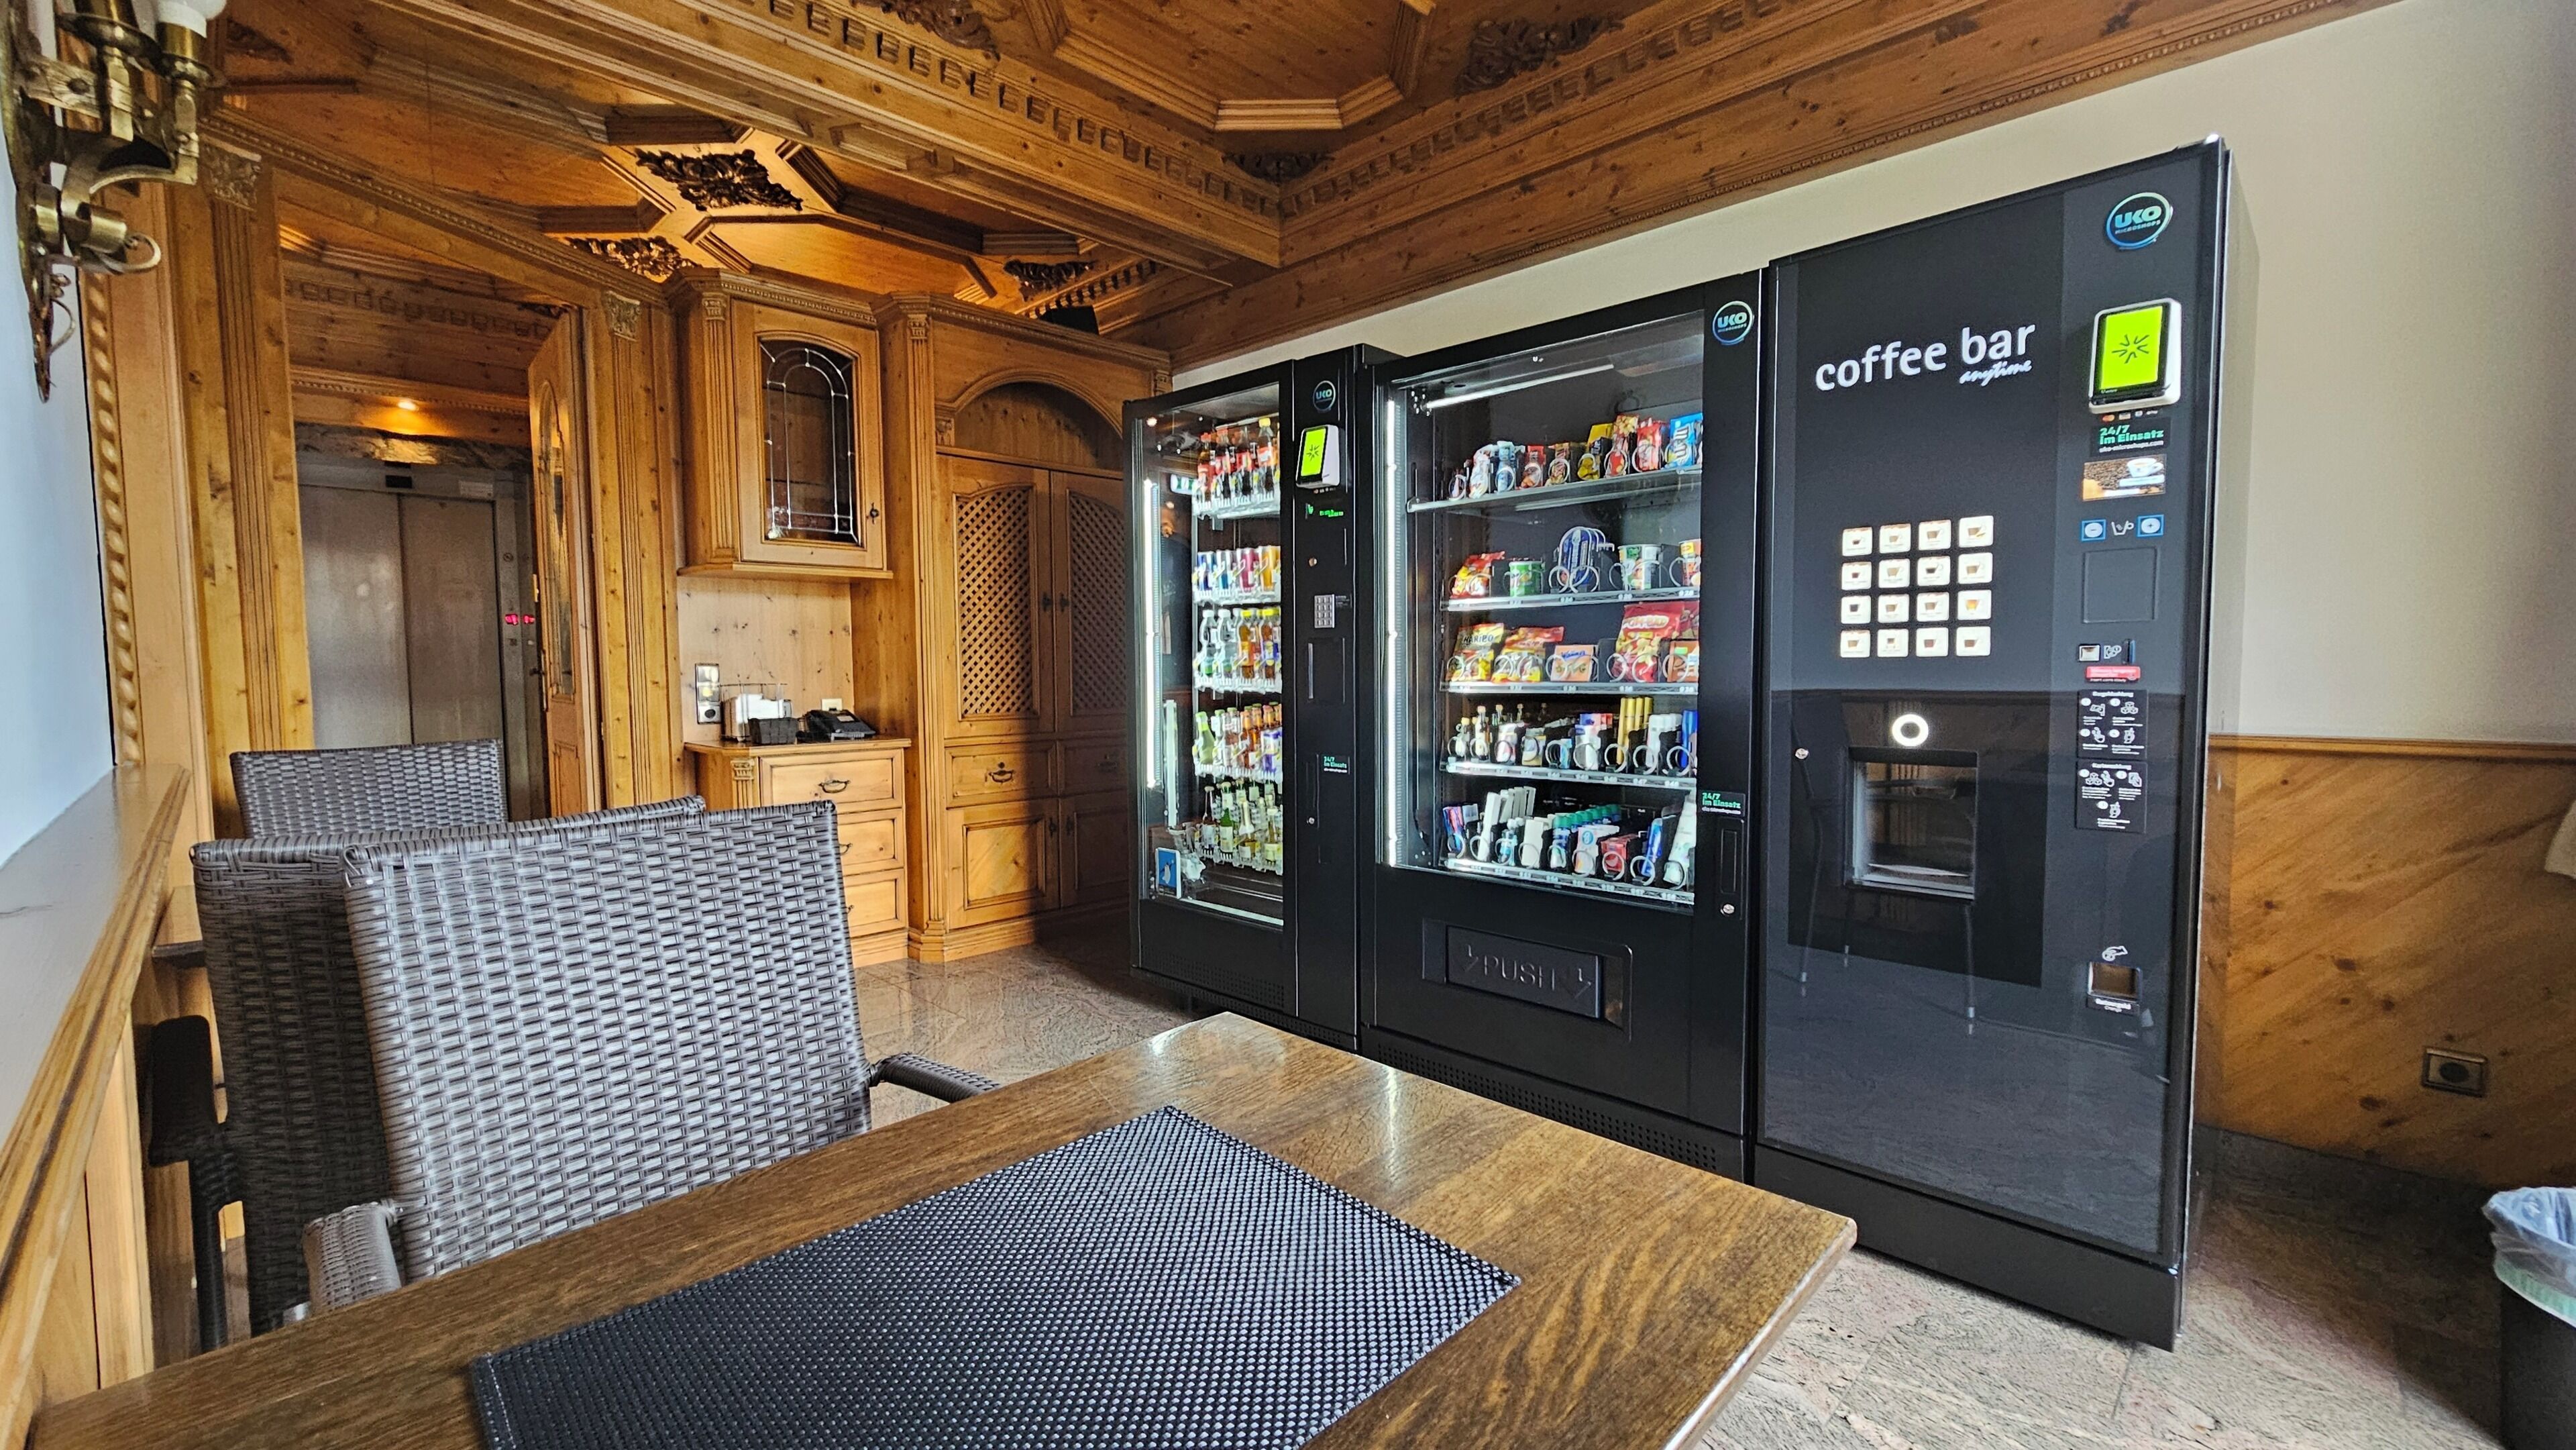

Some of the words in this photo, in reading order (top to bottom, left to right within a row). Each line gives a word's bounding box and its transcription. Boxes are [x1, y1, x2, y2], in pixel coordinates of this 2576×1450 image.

[2114, 205, 2162, 228] UKO
[1717, 312, 1748, 327] UKO
[1815, 340, 1947, 391] coffee
[1960, 323, 2036, 364] bar
[1959, 359, 2033, 387] anytime
[1316, 388, 1332, 400] UKO
[2099, 424, 2131, 436] 24/7
[2117, 429, 2164, 443] Einsatz
[1463, 634, 1494, 643] HARIBO
[1483, 955, 1556, 991] PUSH
